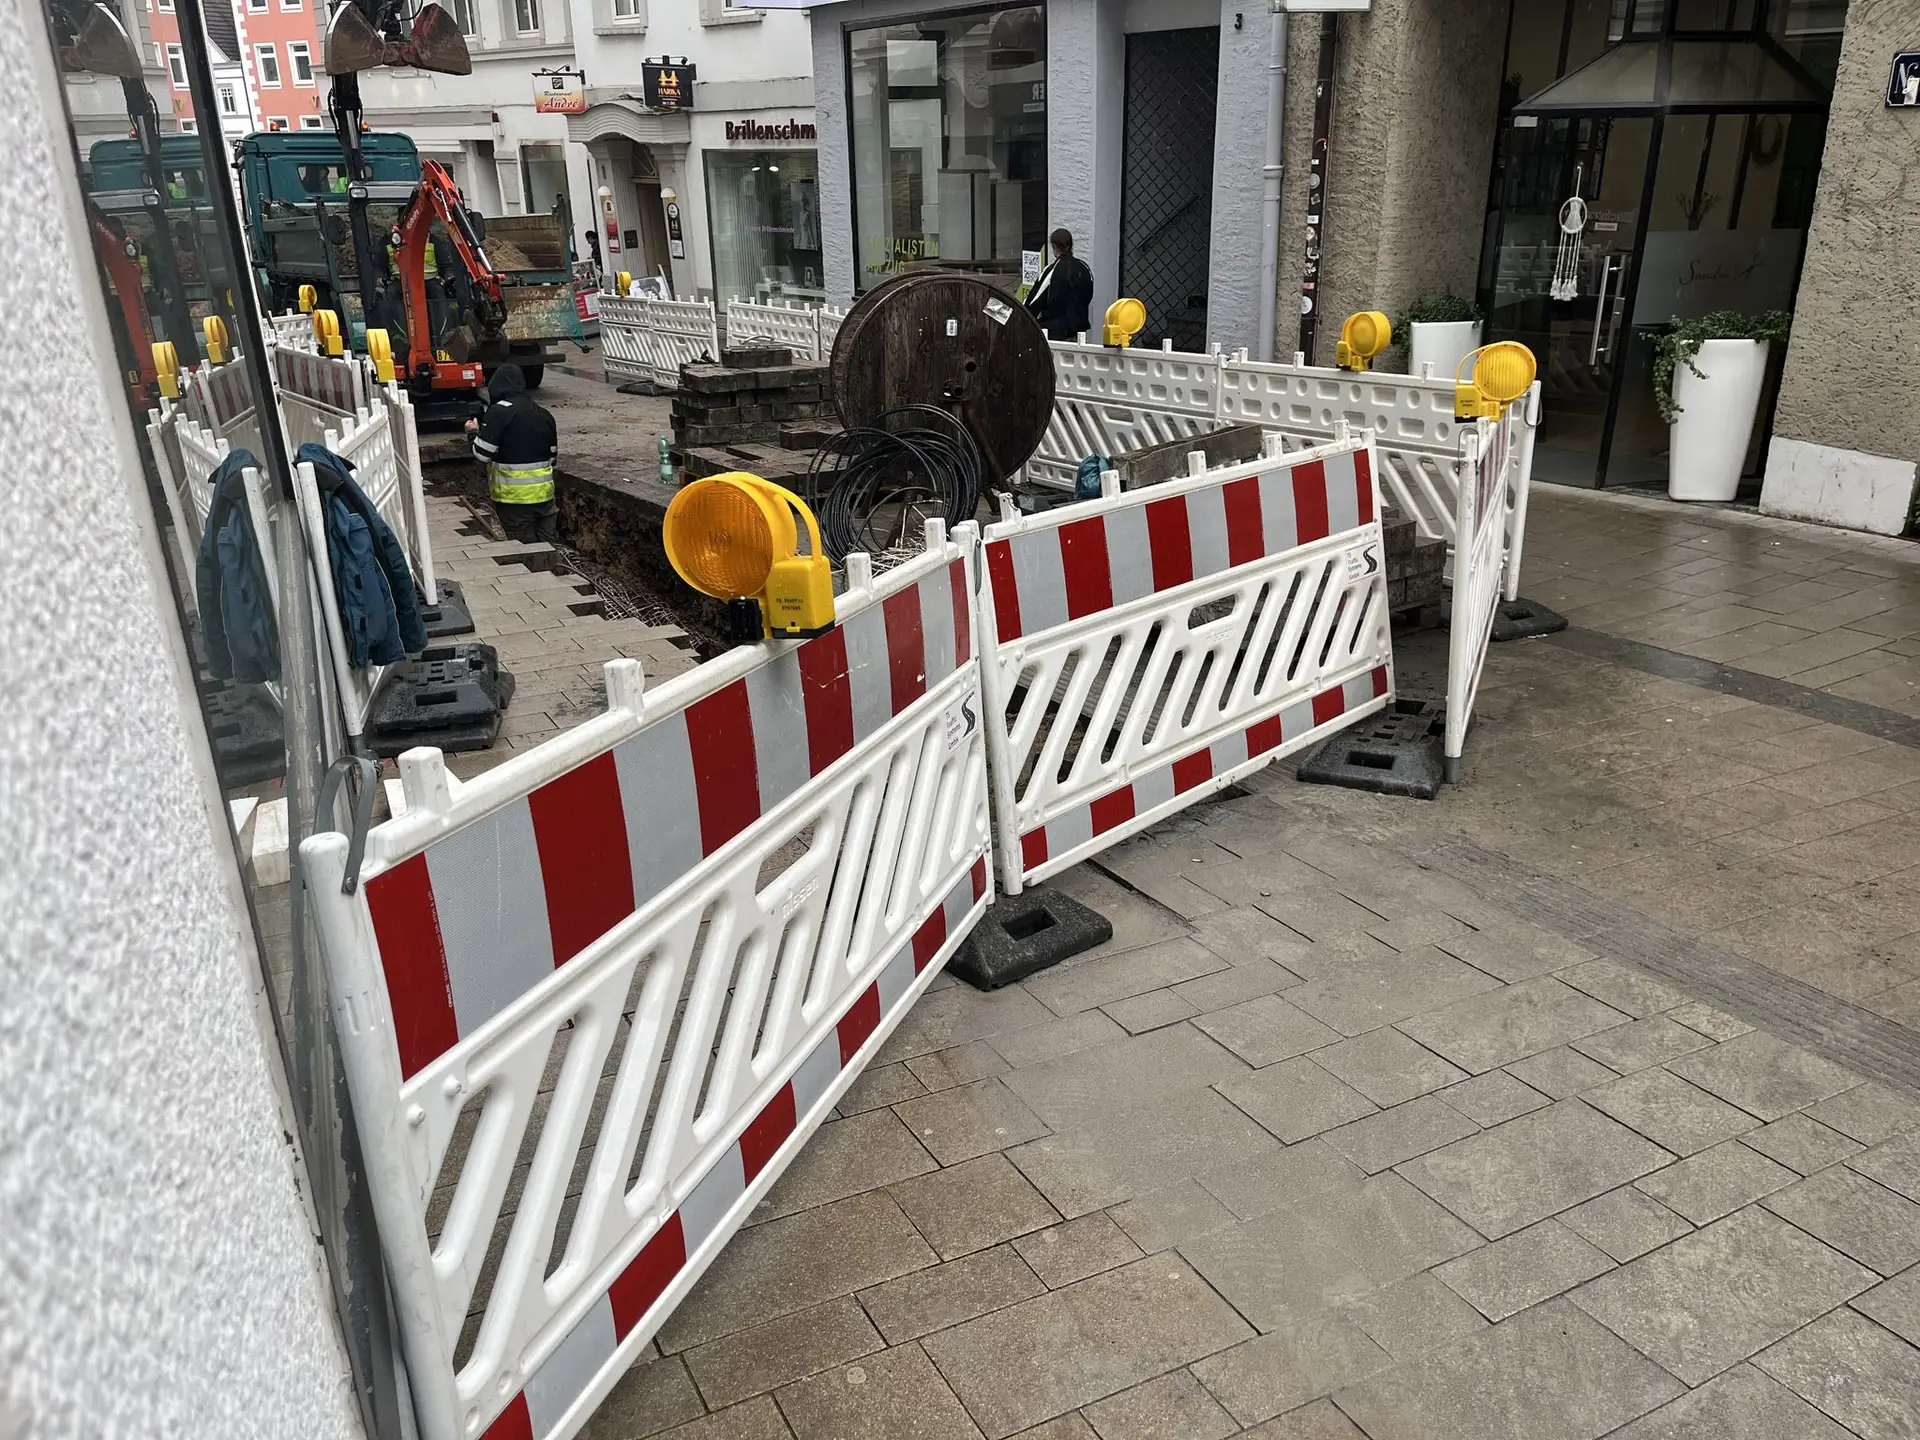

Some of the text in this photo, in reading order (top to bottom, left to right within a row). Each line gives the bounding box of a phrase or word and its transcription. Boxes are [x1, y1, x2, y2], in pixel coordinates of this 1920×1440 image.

[1234, 12, 1243, 30] 3
[540, 97, 579, 111] André
[725, 118, 817, 140] Brillenschm
